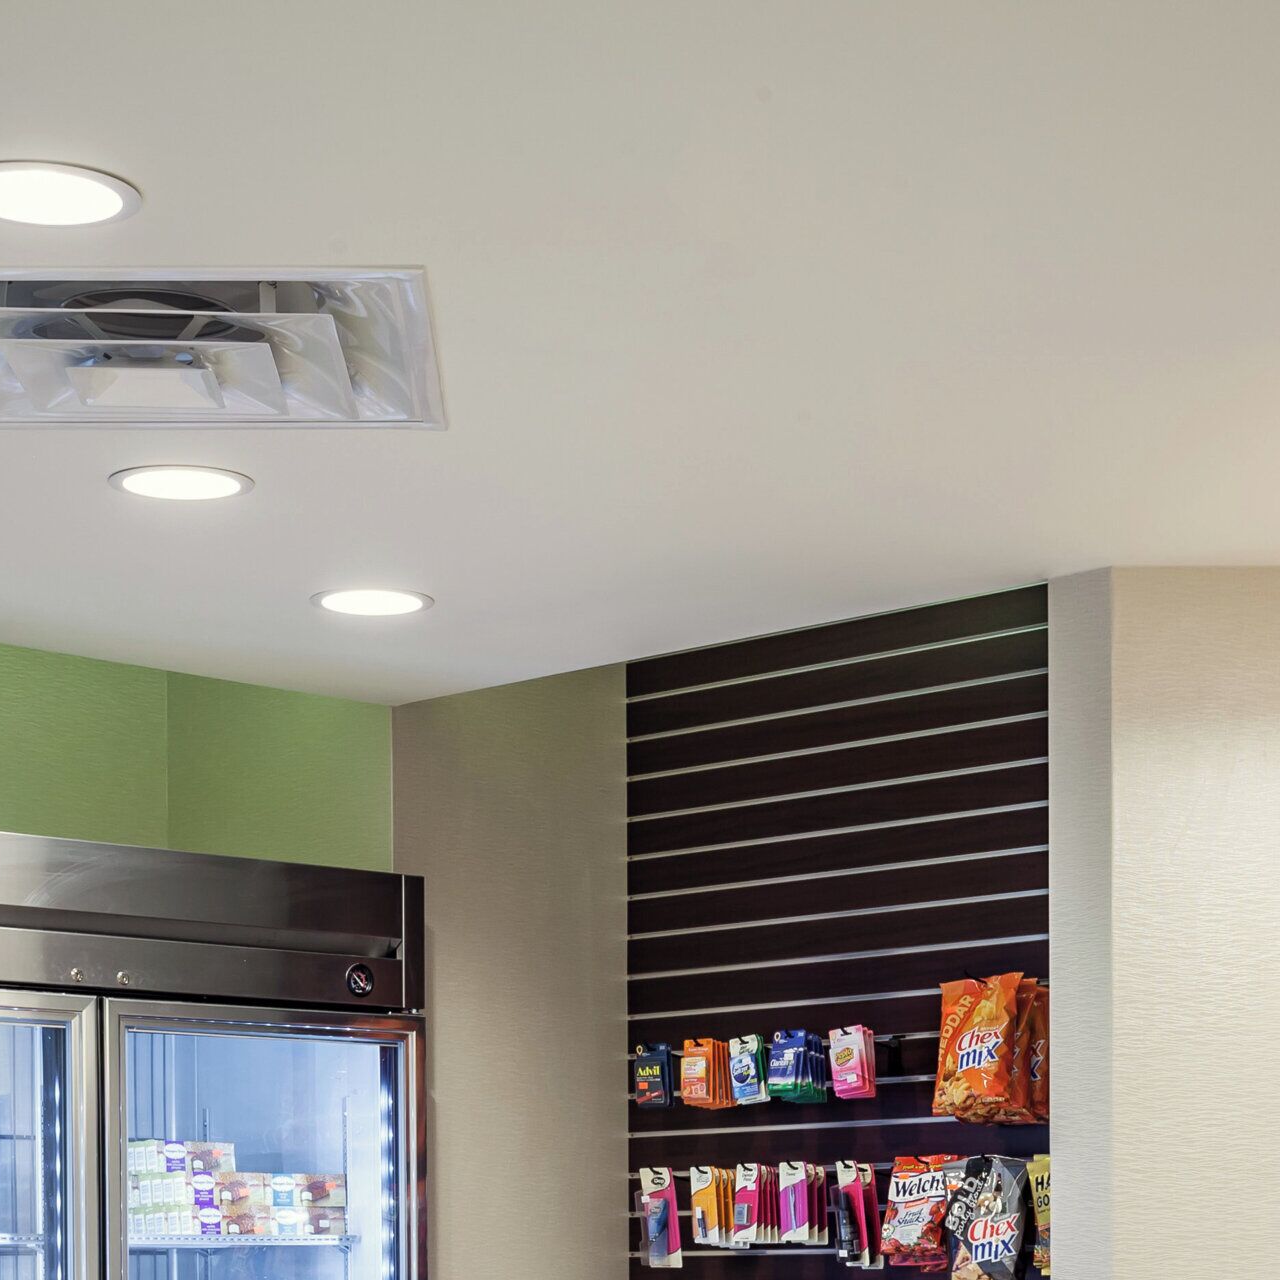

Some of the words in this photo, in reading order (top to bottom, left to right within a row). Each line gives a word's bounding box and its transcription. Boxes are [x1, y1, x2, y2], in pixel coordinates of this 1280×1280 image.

[938, 994, 975, 1060] HEDDAR
[958, 1023, 1007, 1051] Chex
[959, 1042, 998, 1071] mix
[637, 1066, 660, 1076] Advil
[945, 1177, 977, 1230] BOLD
[896, 1215, 925, 1228] Snacks
[969, 1214, 1018, 1242] Chex
[973, 1234, 1016, 1263] mix
